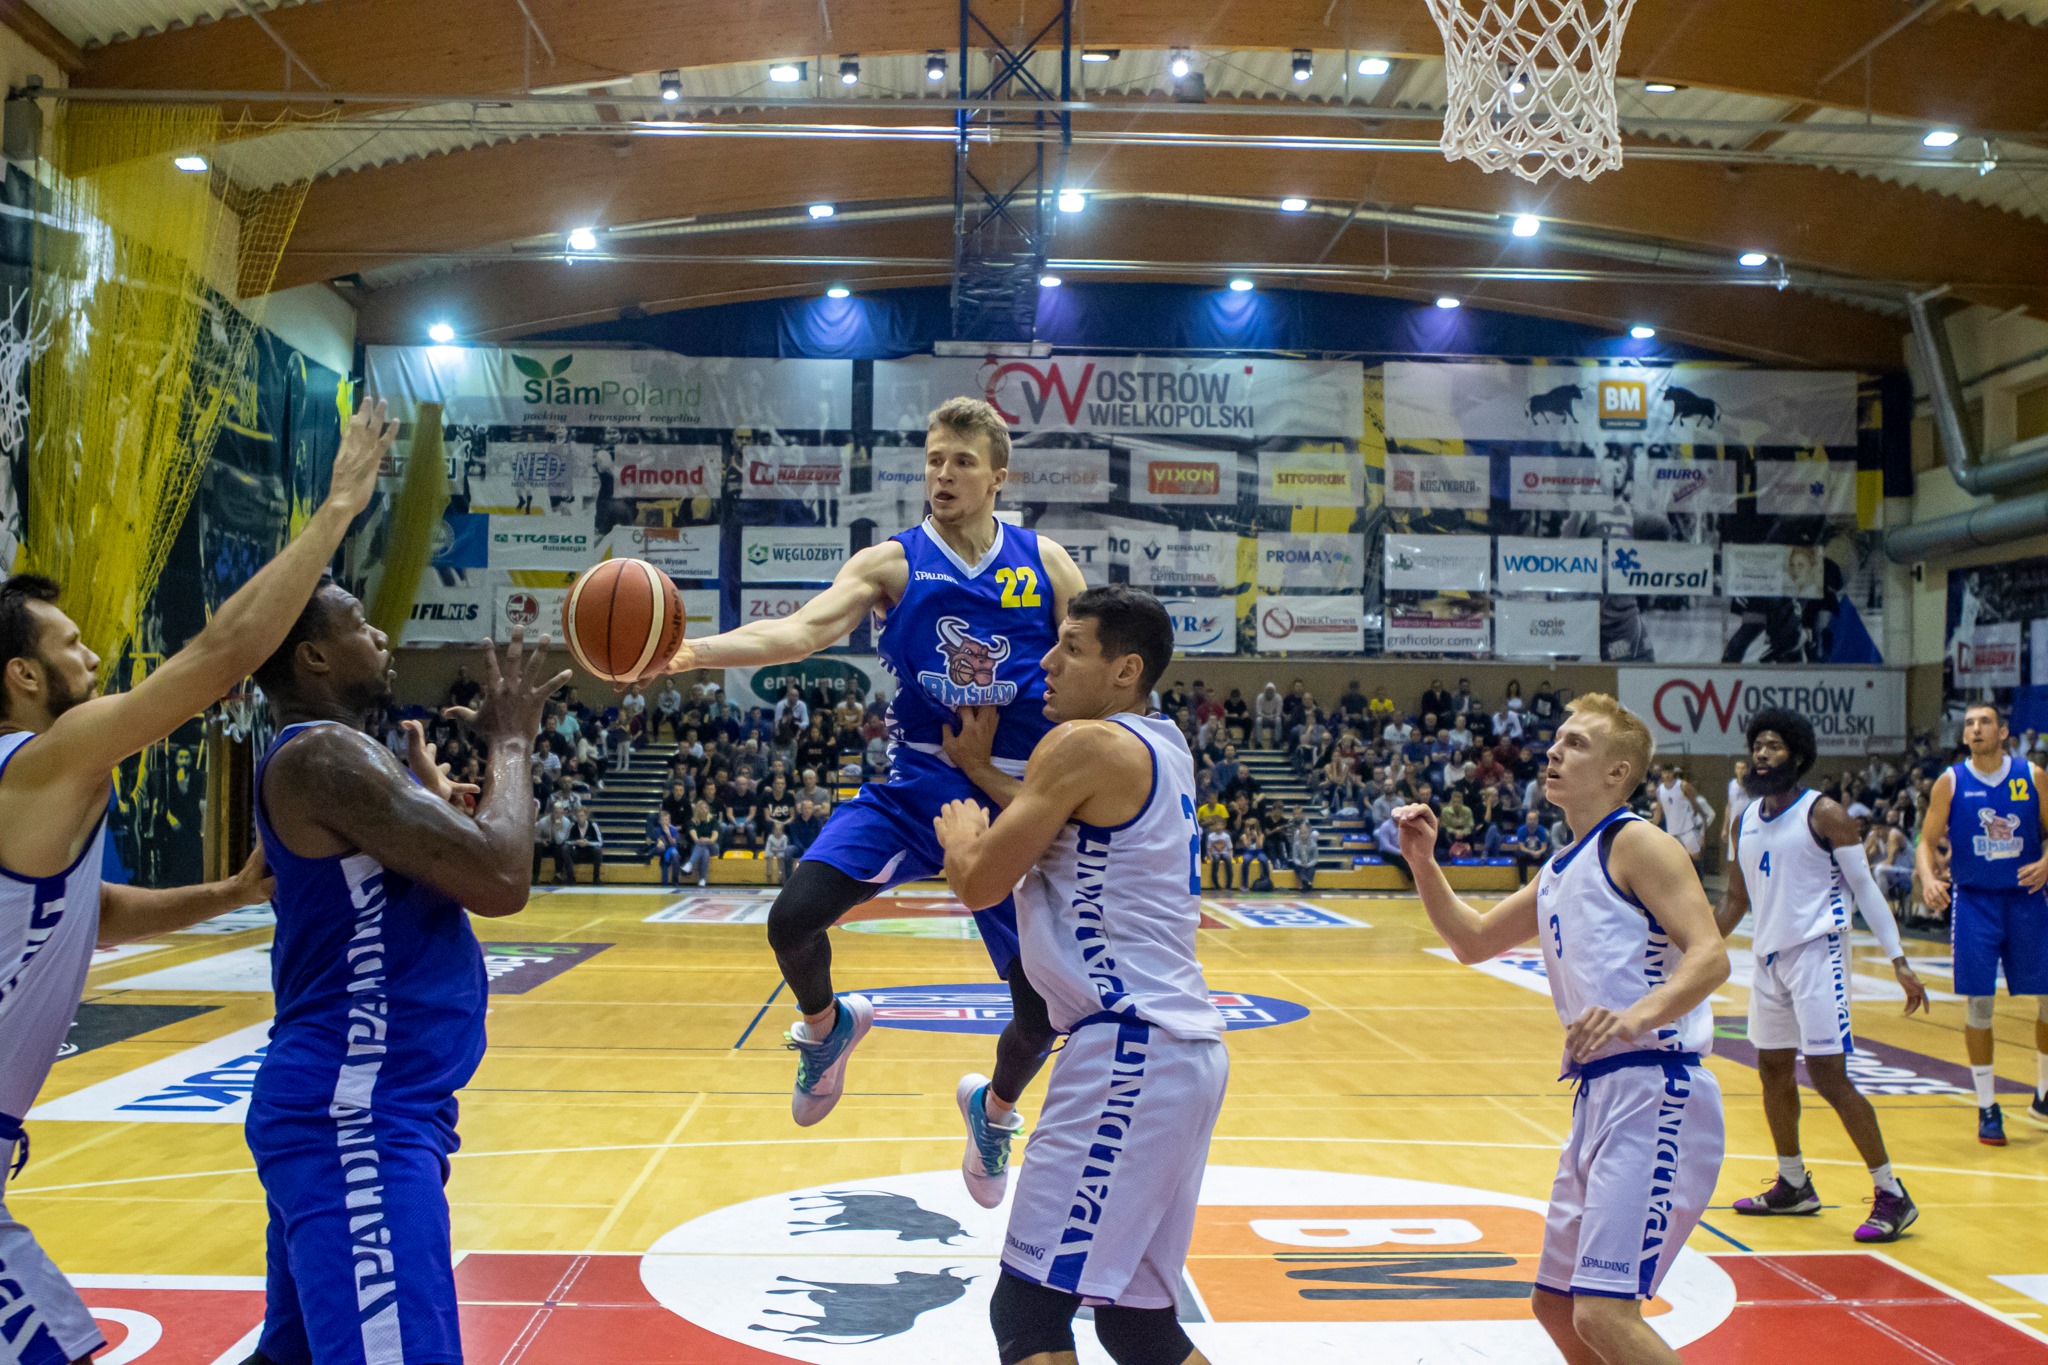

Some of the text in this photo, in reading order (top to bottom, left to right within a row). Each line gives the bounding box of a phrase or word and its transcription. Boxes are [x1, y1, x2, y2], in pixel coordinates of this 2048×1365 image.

[1096, 364, 1231, 404] OSTRÓW
[1605, 386, 1641, 411] BM
[523, 411, 701, 424] packing transport recycling
[1088, 402, 1254, 428] WIELKOPOLSKI
[620, 464, 704, 486] Amond
[1154, 468, 1215, 482] VIXON
[1276, 472, 1346, 485] SITODRUK
[511, 534, 587, 544] TRASKO
[773, 547, 844, 562] WĘGLOZBYT
[1266, 550, 1333, 563] PROMAX
[1503, 555, 1598, 573] WODKAN
[914, 571, 959, 585] SPALDING
[994, 567, 1041, 608] 22
[1628, 569, 1709, 588] marsal
[1744, 680, 1855, 714] OSTRÓW
[1738, 713, 1874, 736] WPOLSKI
[2009, 778, 2031, 801] 12
[1758, 850, 1771, 877] 4
[1550, 913, 1562, 959] 3
[114, 1046, 268, 1112] ZUKI
[1580, 1255, 1631, 1275] SPALDING
